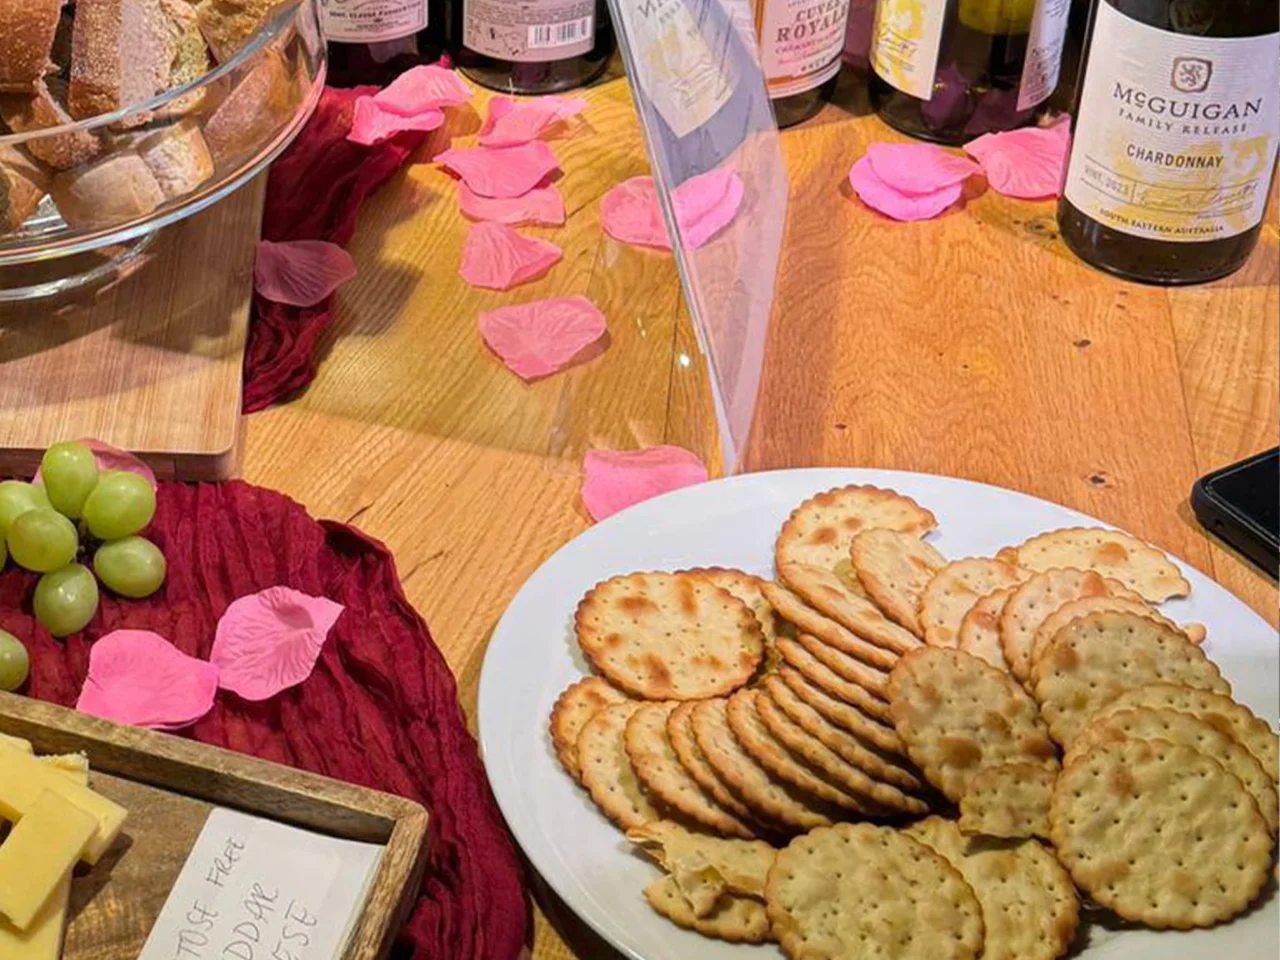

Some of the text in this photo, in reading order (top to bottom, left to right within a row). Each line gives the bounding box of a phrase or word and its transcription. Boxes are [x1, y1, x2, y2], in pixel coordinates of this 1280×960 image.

[775, 1, 849, 43] ROYALE
[1113, 82, 1263, 121] McGUIGAN
[1118, 107, 1248, 137] FAMILY RELEASE
[1126, 143, 1225, 169] CHARDONNAY
[1099, 206, 1225, 236] SOUTH EASTERN AUSTRALIA
[172, 837, 245, 960] TOSE FREE
[221, 882, 279, 960] DDAR
